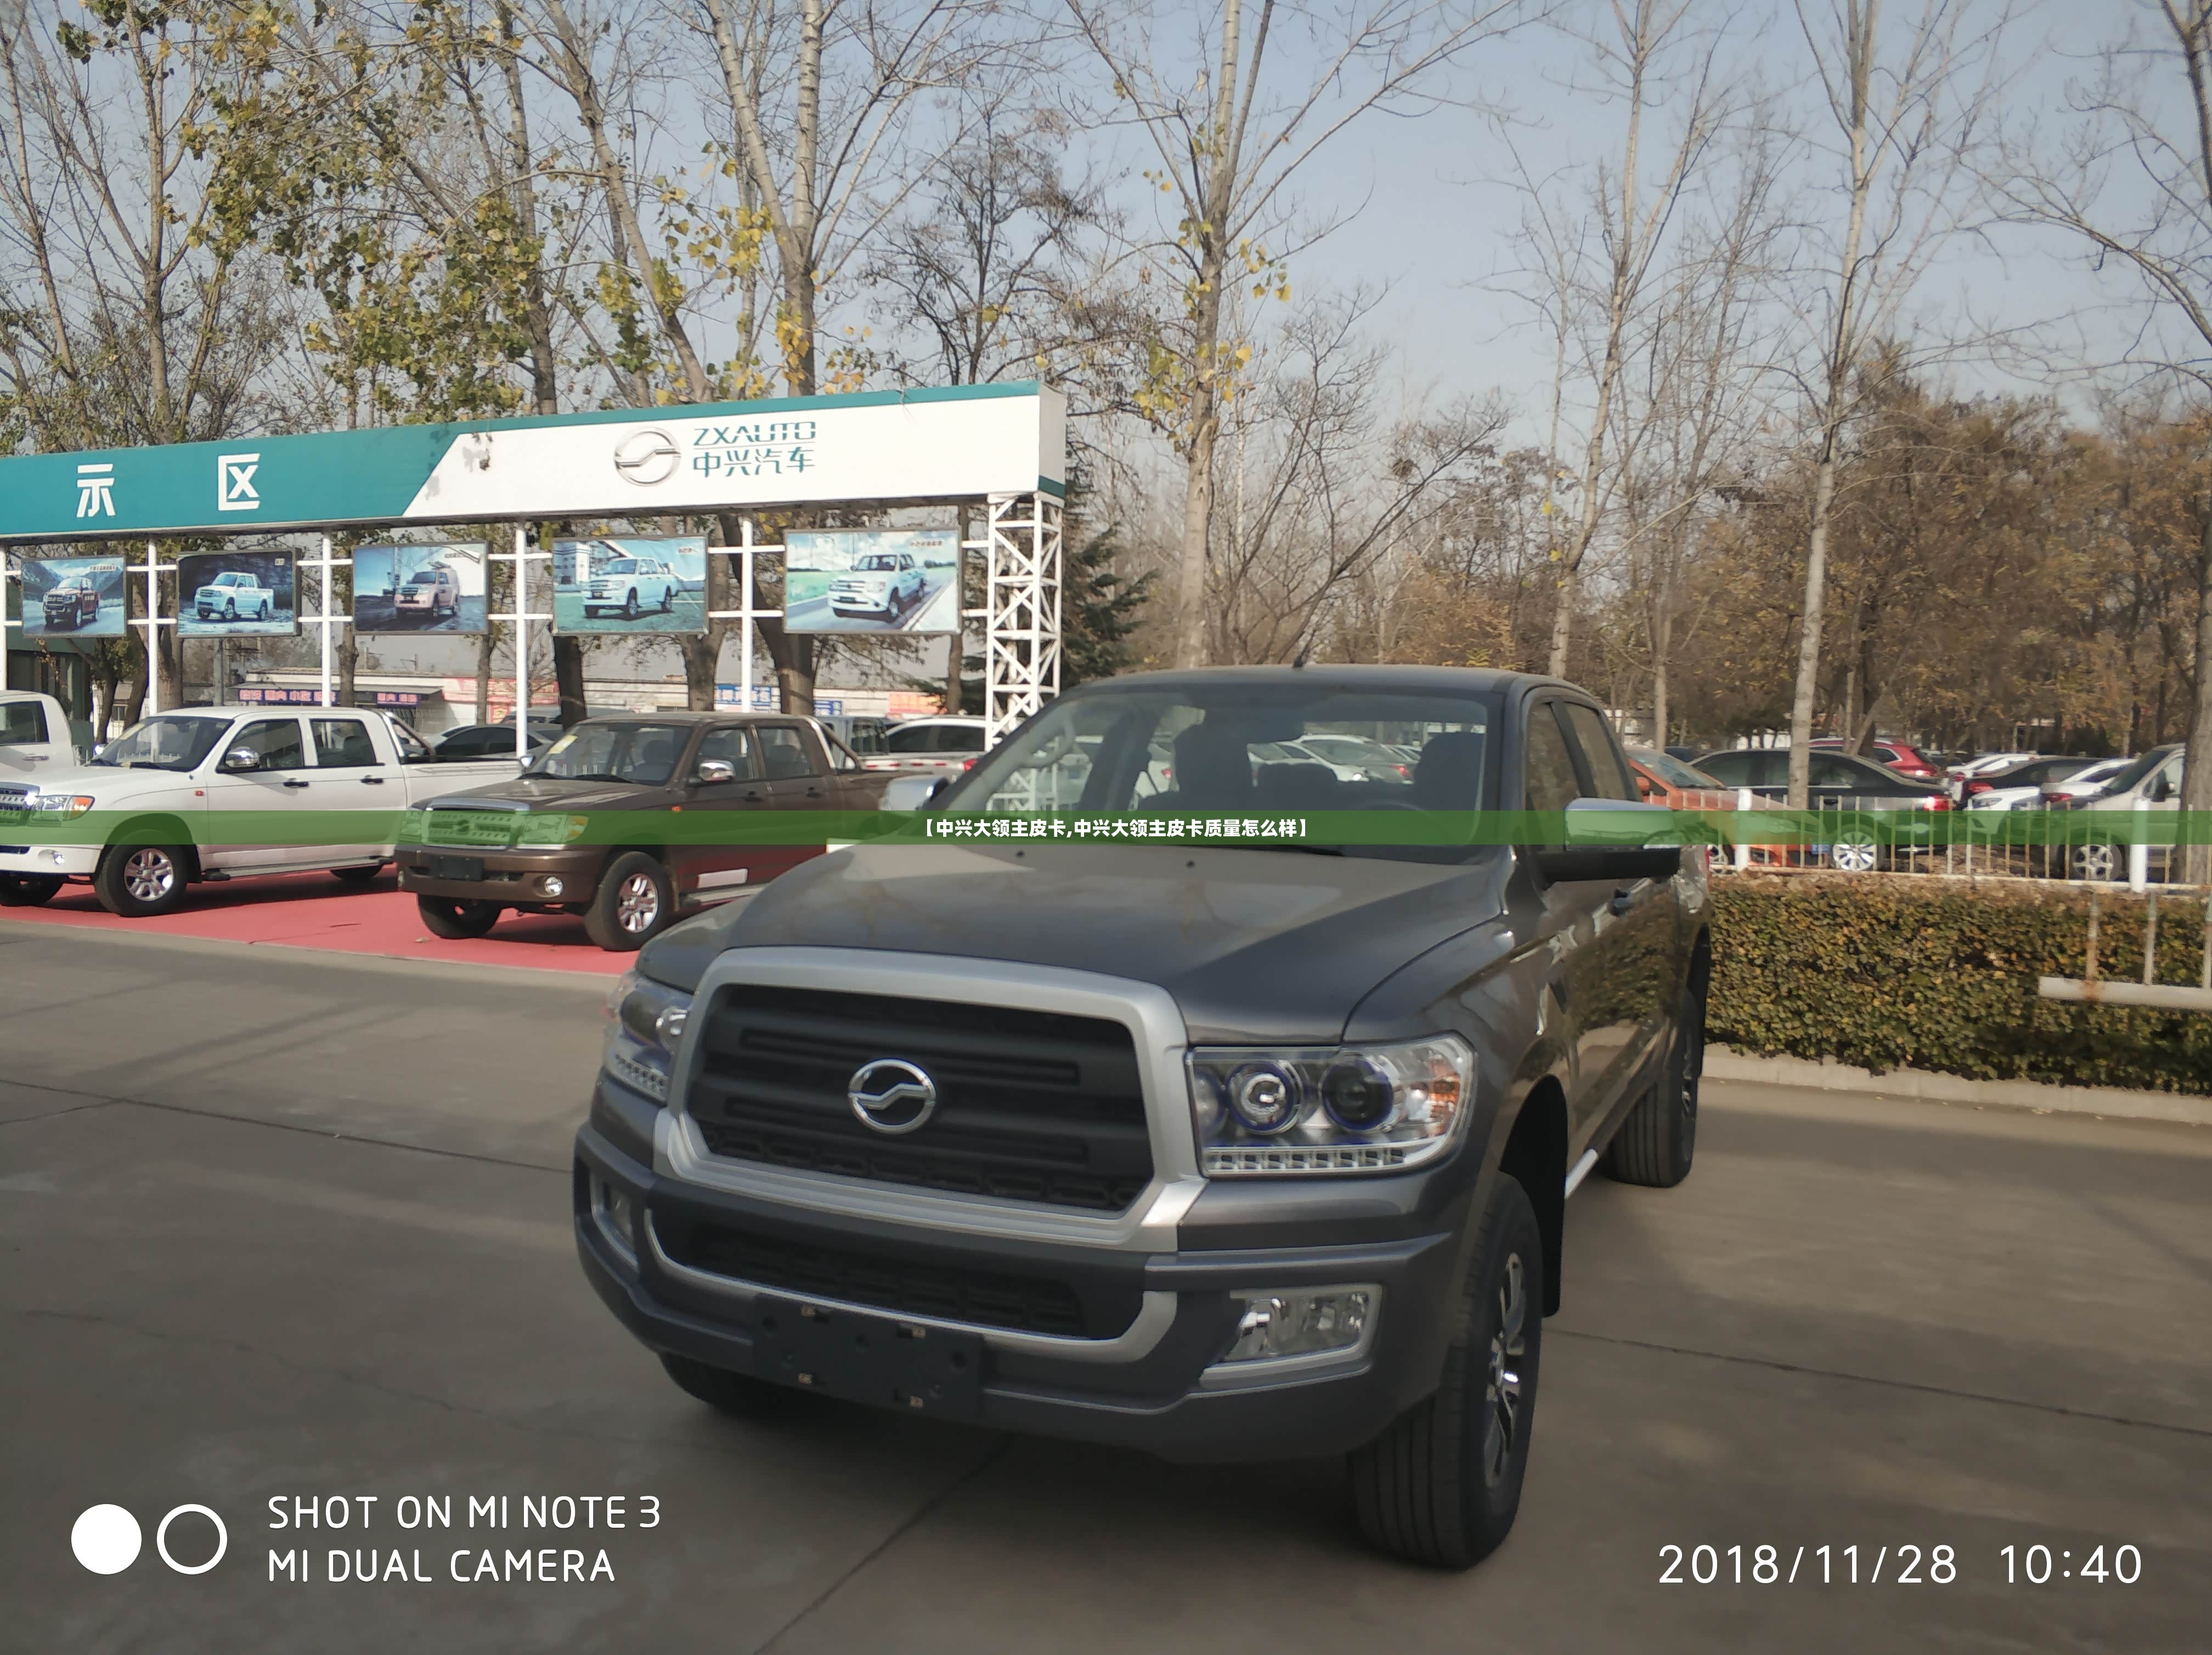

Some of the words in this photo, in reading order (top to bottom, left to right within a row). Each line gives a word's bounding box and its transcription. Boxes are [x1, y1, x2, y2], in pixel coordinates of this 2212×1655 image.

[693, 421, 816, 446] ZXAUTO
[693, 446, 816, 478] 中兴汽车
